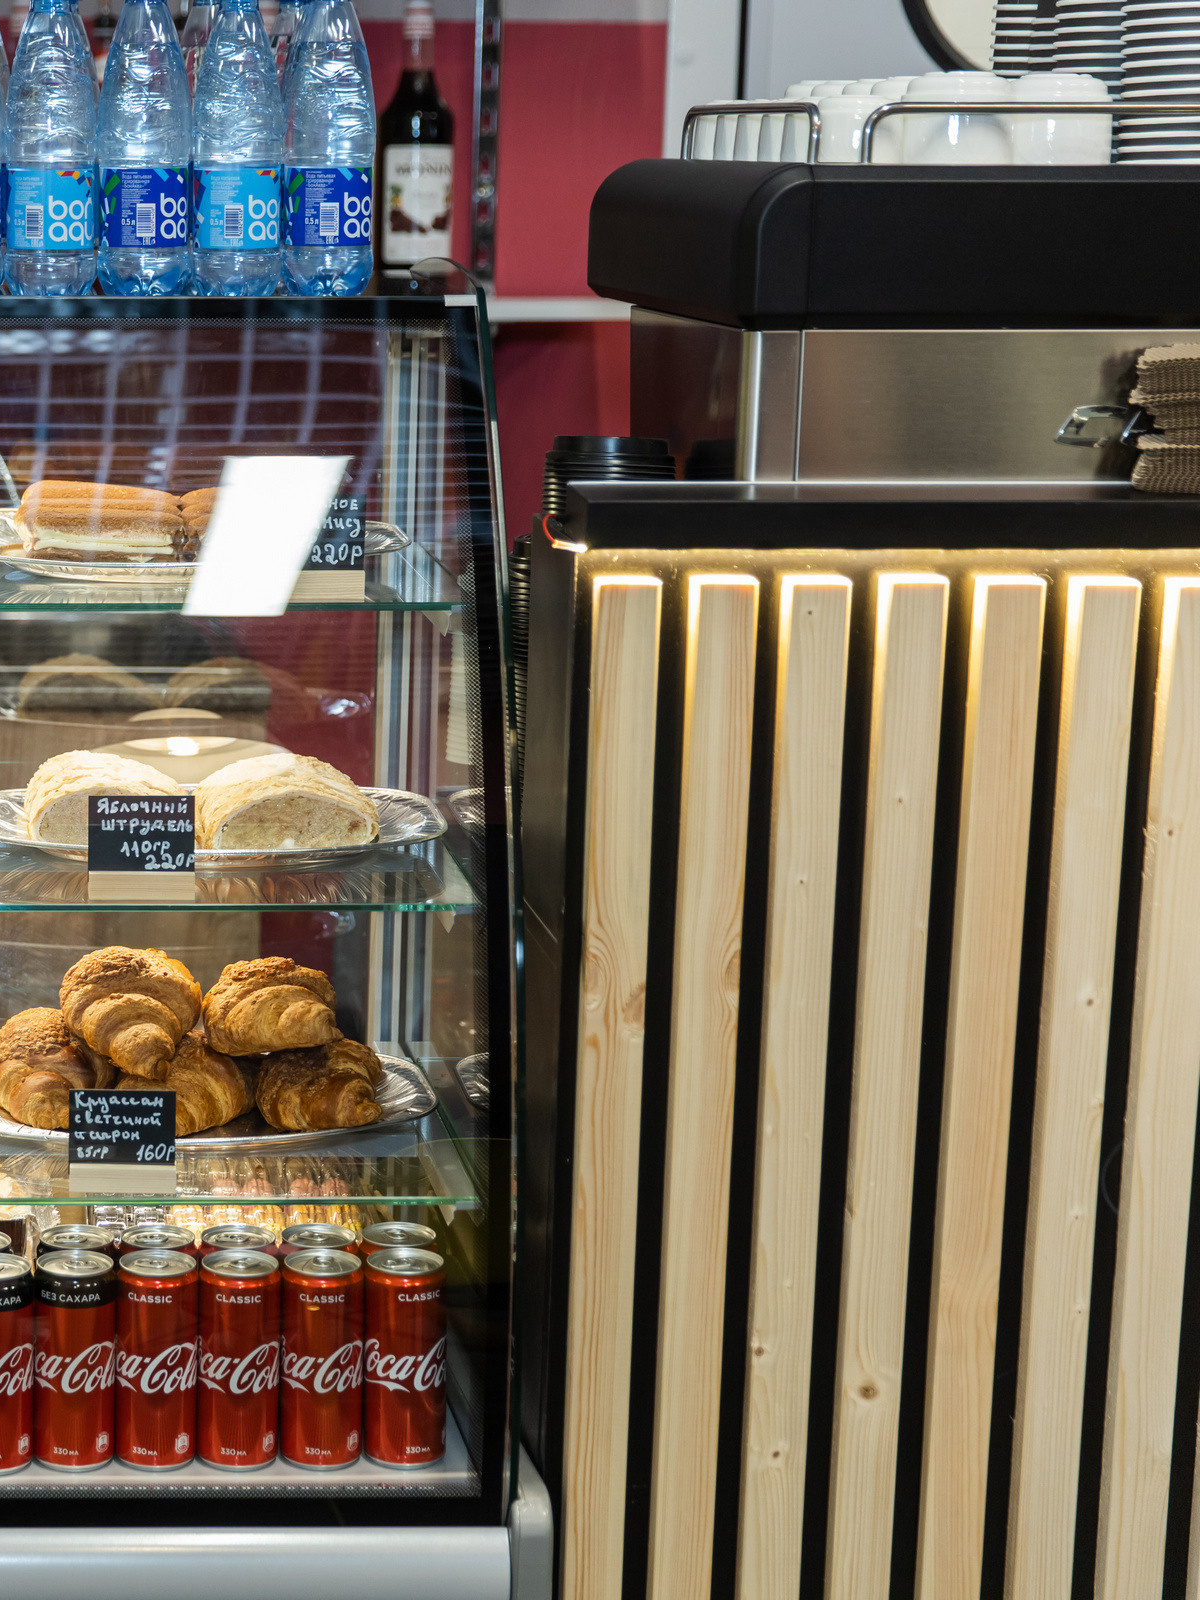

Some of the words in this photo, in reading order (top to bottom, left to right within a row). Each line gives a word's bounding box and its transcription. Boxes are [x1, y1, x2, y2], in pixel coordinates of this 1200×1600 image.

[160, 192, 188, 218] bo
[248, 194, 278, 220] bo
[344, 192, 372, 216] bo
[48, 221, 94, 246] aqu
[160, 218, 188, 243] aq
[248, 220, 278, 245] aq
[344, 218, 372, 242] aq
[74, 1091, 164, 1114] Круассан
[41, 1290, 57, 1300] БЕЗ
[59, 1293, 100, 1303] САХАРА
[127, 1291, 173, 1304] CLASSIC
[216, 1293, 262, 1304] CLASSIC
[299, 1293, 345, 1303] CLASSIC
[398, 1289, 440, 1302] CLASSIC
